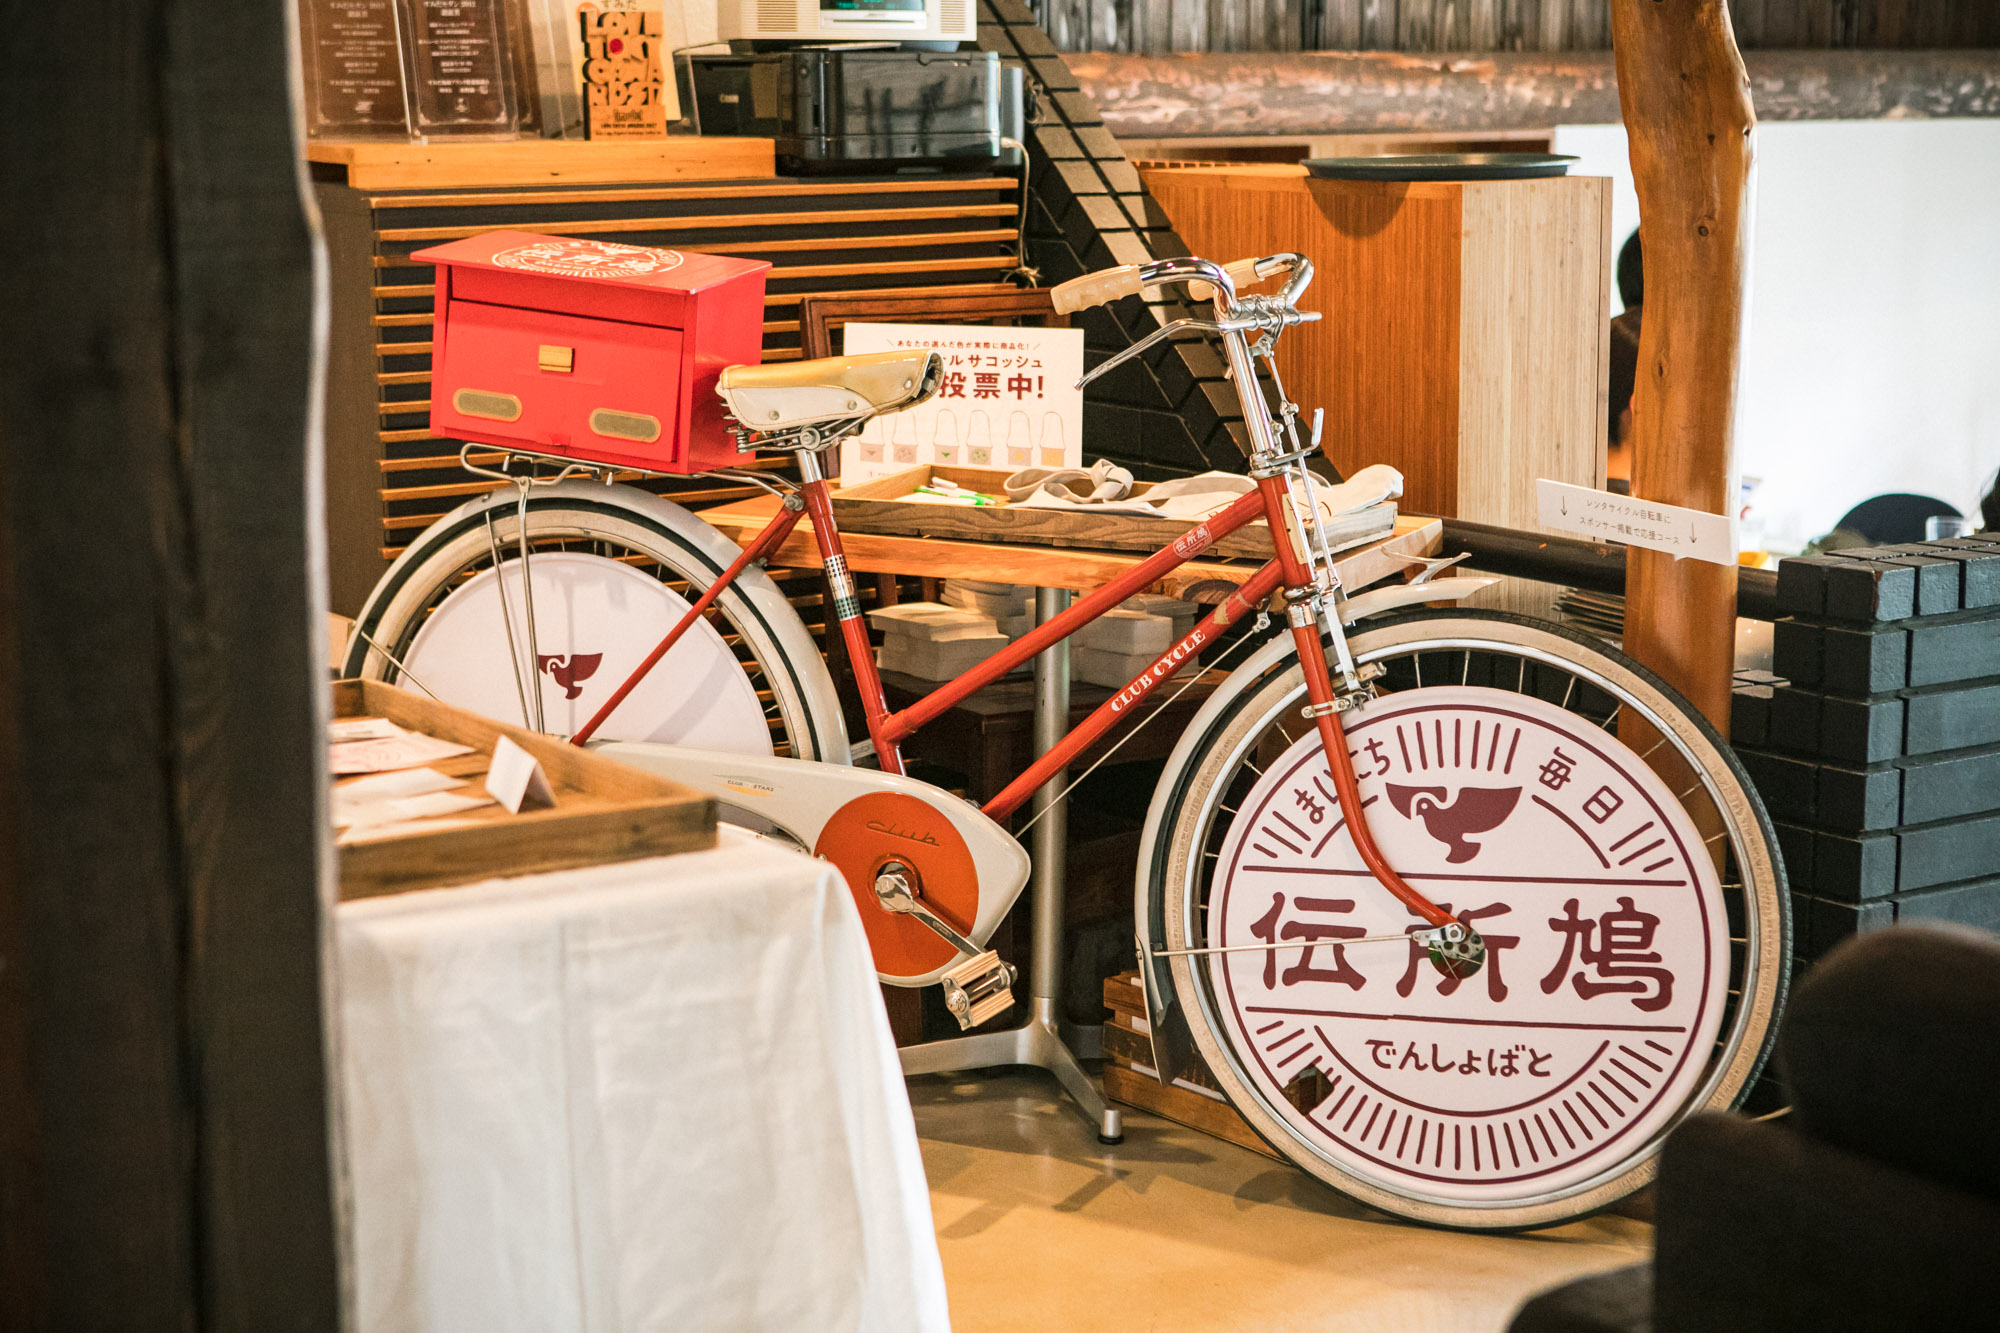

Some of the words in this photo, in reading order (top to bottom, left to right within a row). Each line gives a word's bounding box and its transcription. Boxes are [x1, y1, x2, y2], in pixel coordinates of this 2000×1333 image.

[943, 354, 1043, 369] ルサコッシュ
[1110, 677, 1153, 712] CLUB
[1153, 629, 1206, 676] CYCLE
[1250, 892, 1675, 1012] 伝所鳩
[1366, 1037, 1552, 1078] でんしょばと
